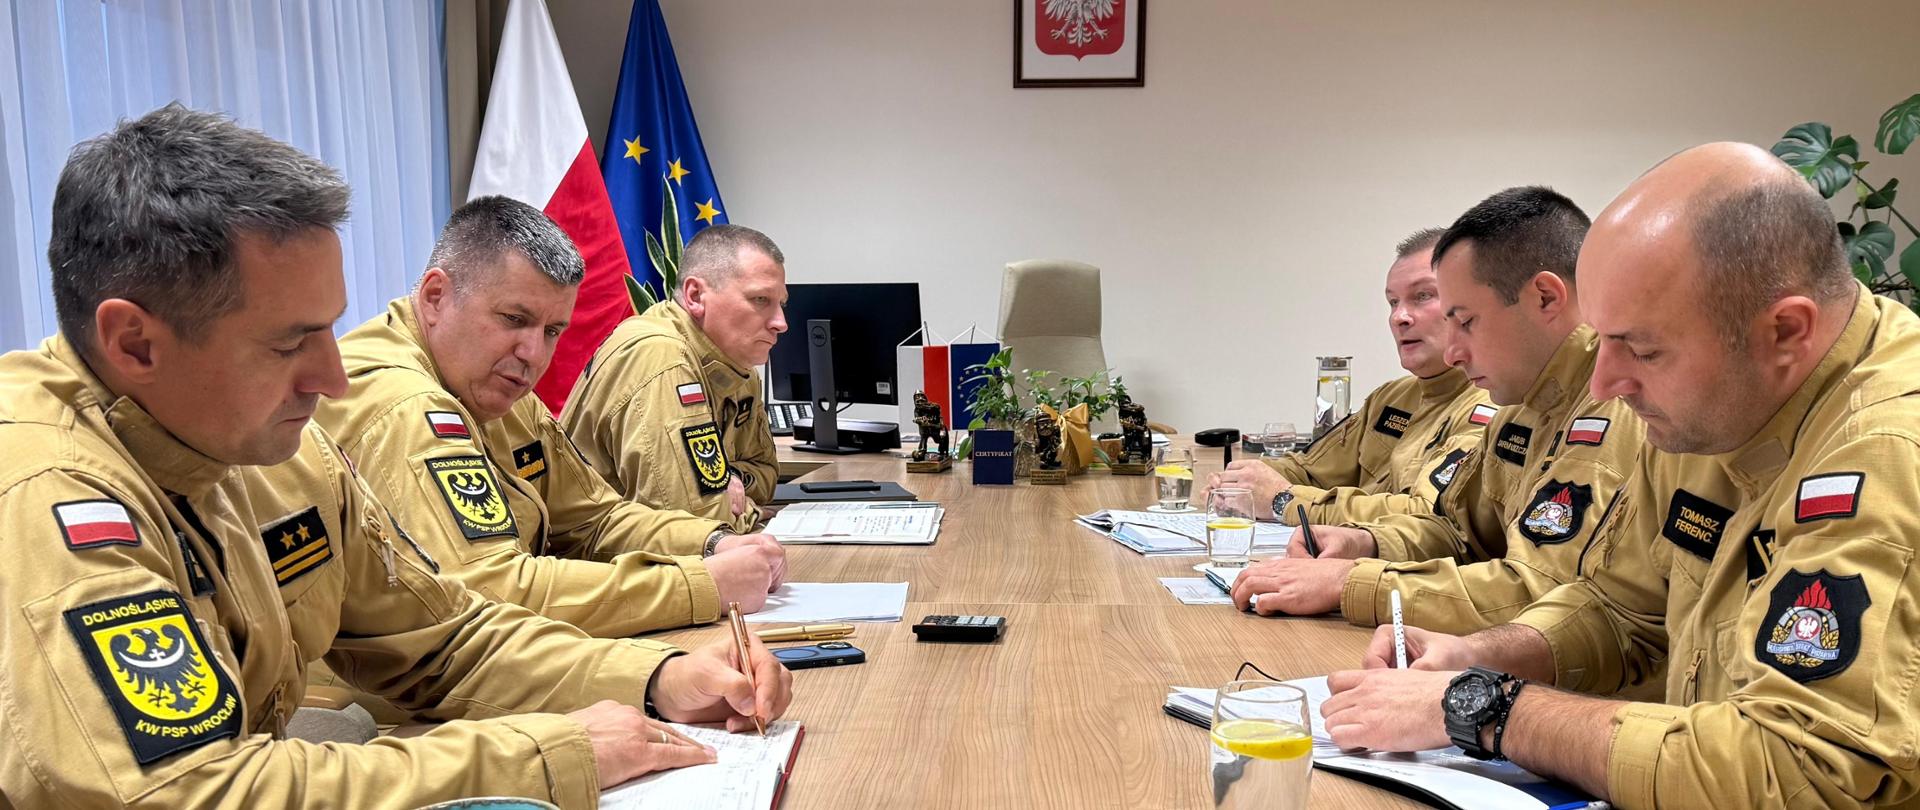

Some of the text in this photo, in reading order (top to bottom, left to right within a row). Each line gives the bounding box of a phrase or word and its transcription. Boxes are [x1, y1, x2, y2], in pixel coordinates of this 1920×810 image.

[1674, 518, 1713, 543] FERENC
[1680, 505, 1720, 532] TOMASZ
[82, 598, 179, 626] DOLNOŚLĄSKIE
[135, 692, 237, 738] KW PSP WROCŁAW
